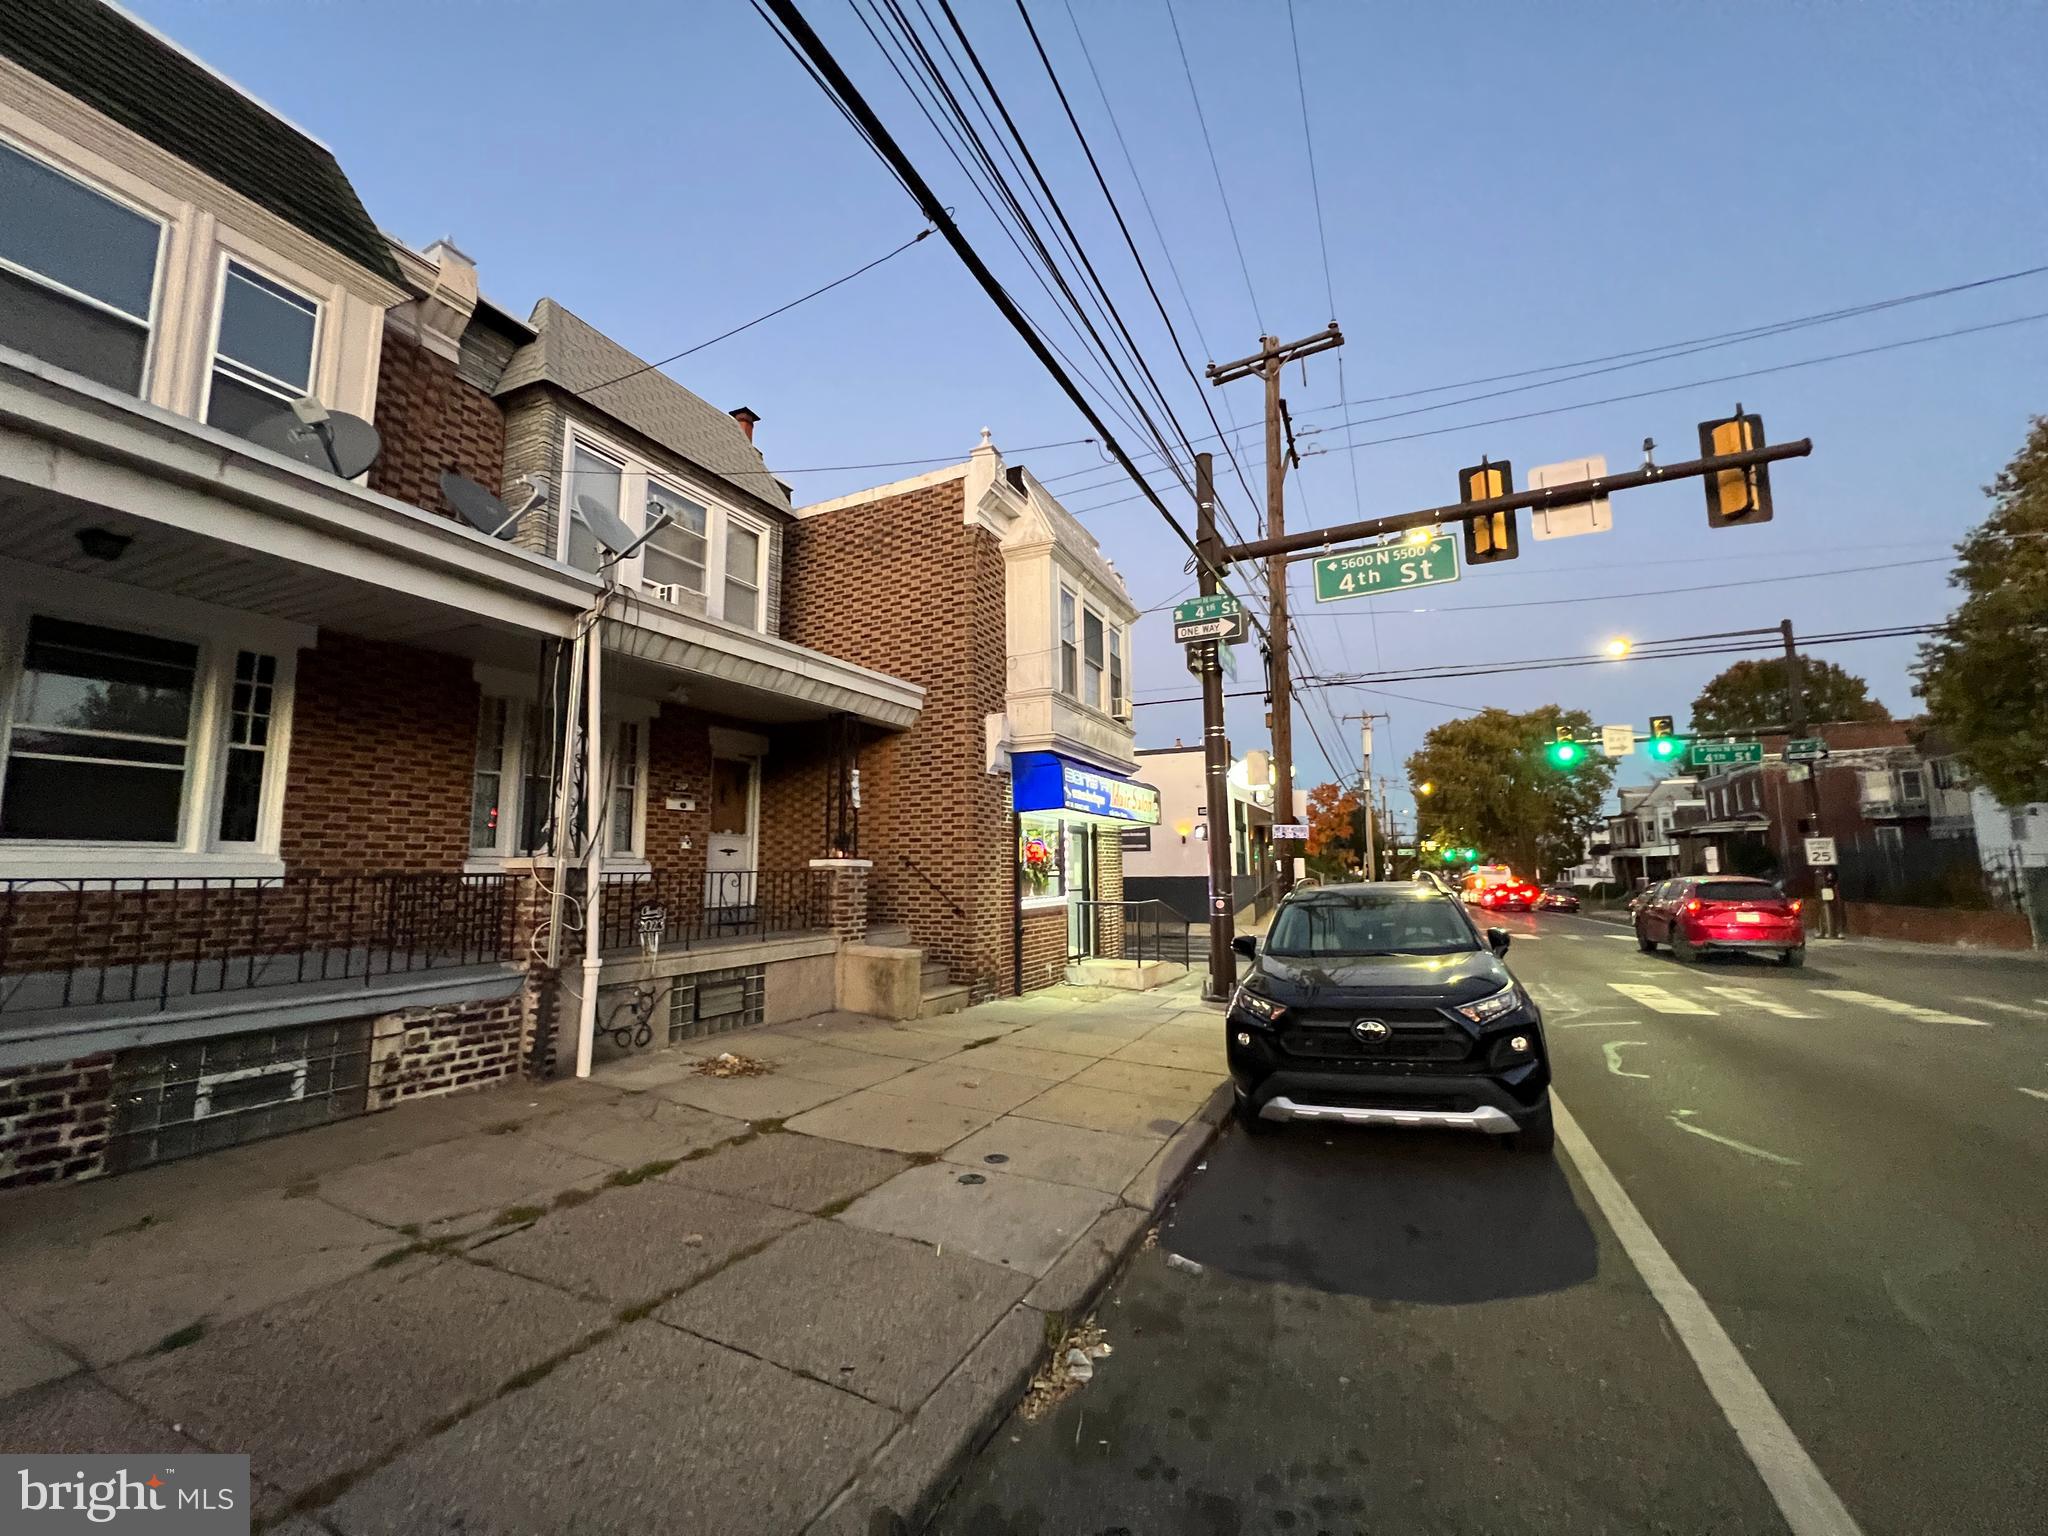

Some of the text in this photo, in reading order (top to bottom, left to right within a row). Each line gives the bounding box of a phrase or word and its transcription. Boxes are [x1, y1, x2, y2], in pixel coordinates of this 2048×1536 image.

[1341, 546, 1426, 570] 5600 N 5500
[1339, 559, 1434, 592] 4th St
[1195, 603, 1216, 618] 4th
[1221, 600, 1239, 614] St
[1181, 624, 1220, 637] ONE WAY
[1812, 852, 1832, 862] 25
